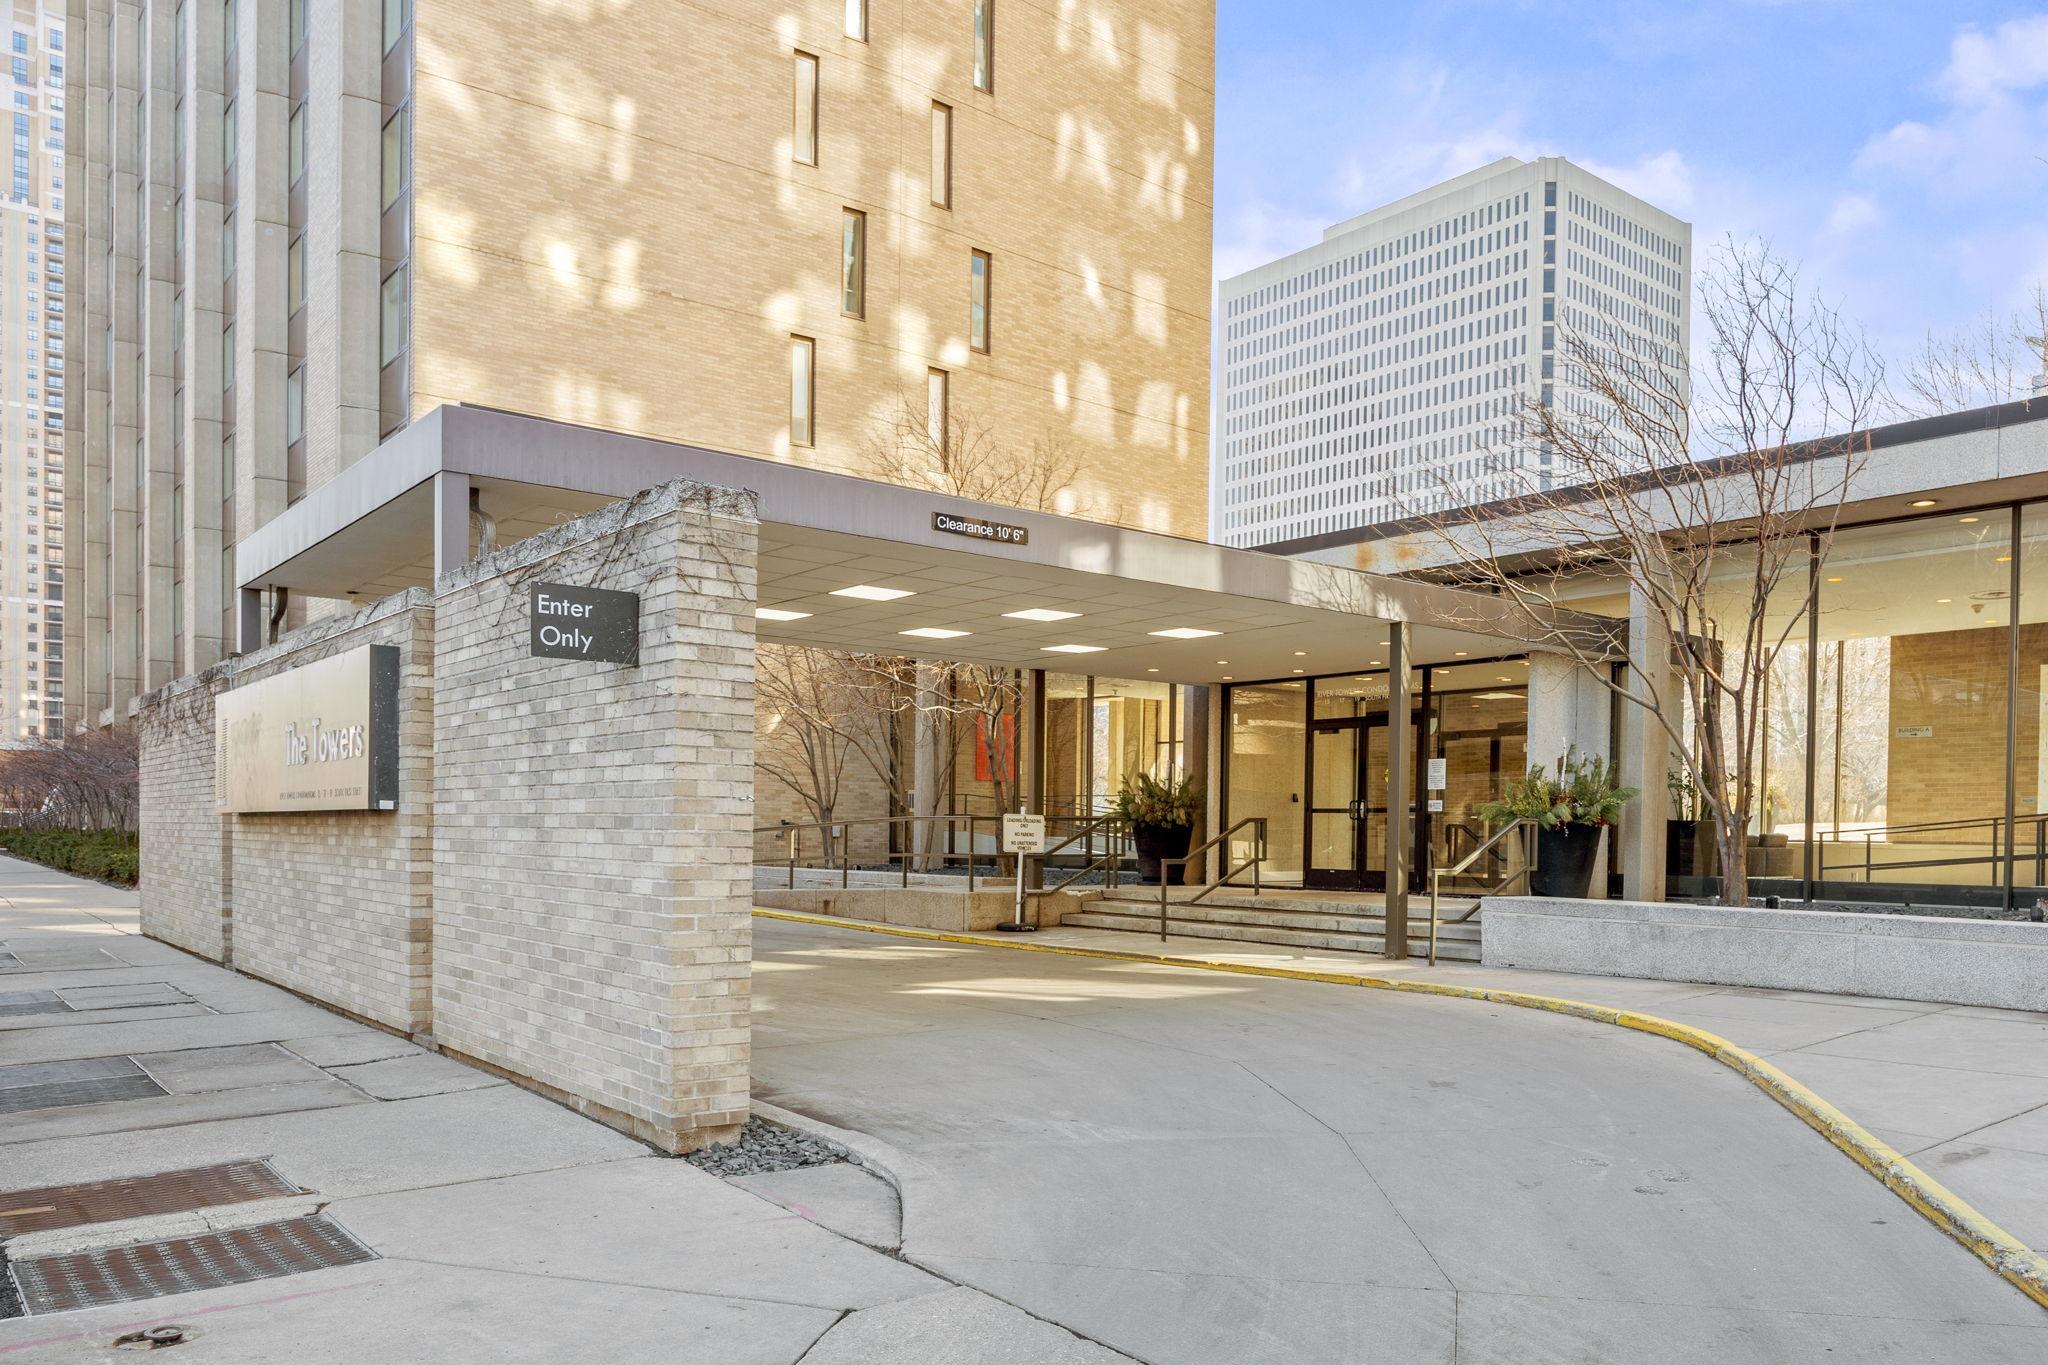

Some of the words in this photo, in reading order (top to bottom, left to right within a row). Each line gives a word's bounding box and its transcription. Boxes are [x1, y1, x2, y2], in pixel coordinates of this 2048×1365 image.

[937, 516, 993, 536] Clearance
[996, 527, 1011, 539] 10'
[1013, 529, 1024, 541] 6"
[538, 594, 593, 618] Enter
[540, 625, 593, 654] Only
[286, 721, 307, 767] The
[312, 718, 364, 763] Towers
